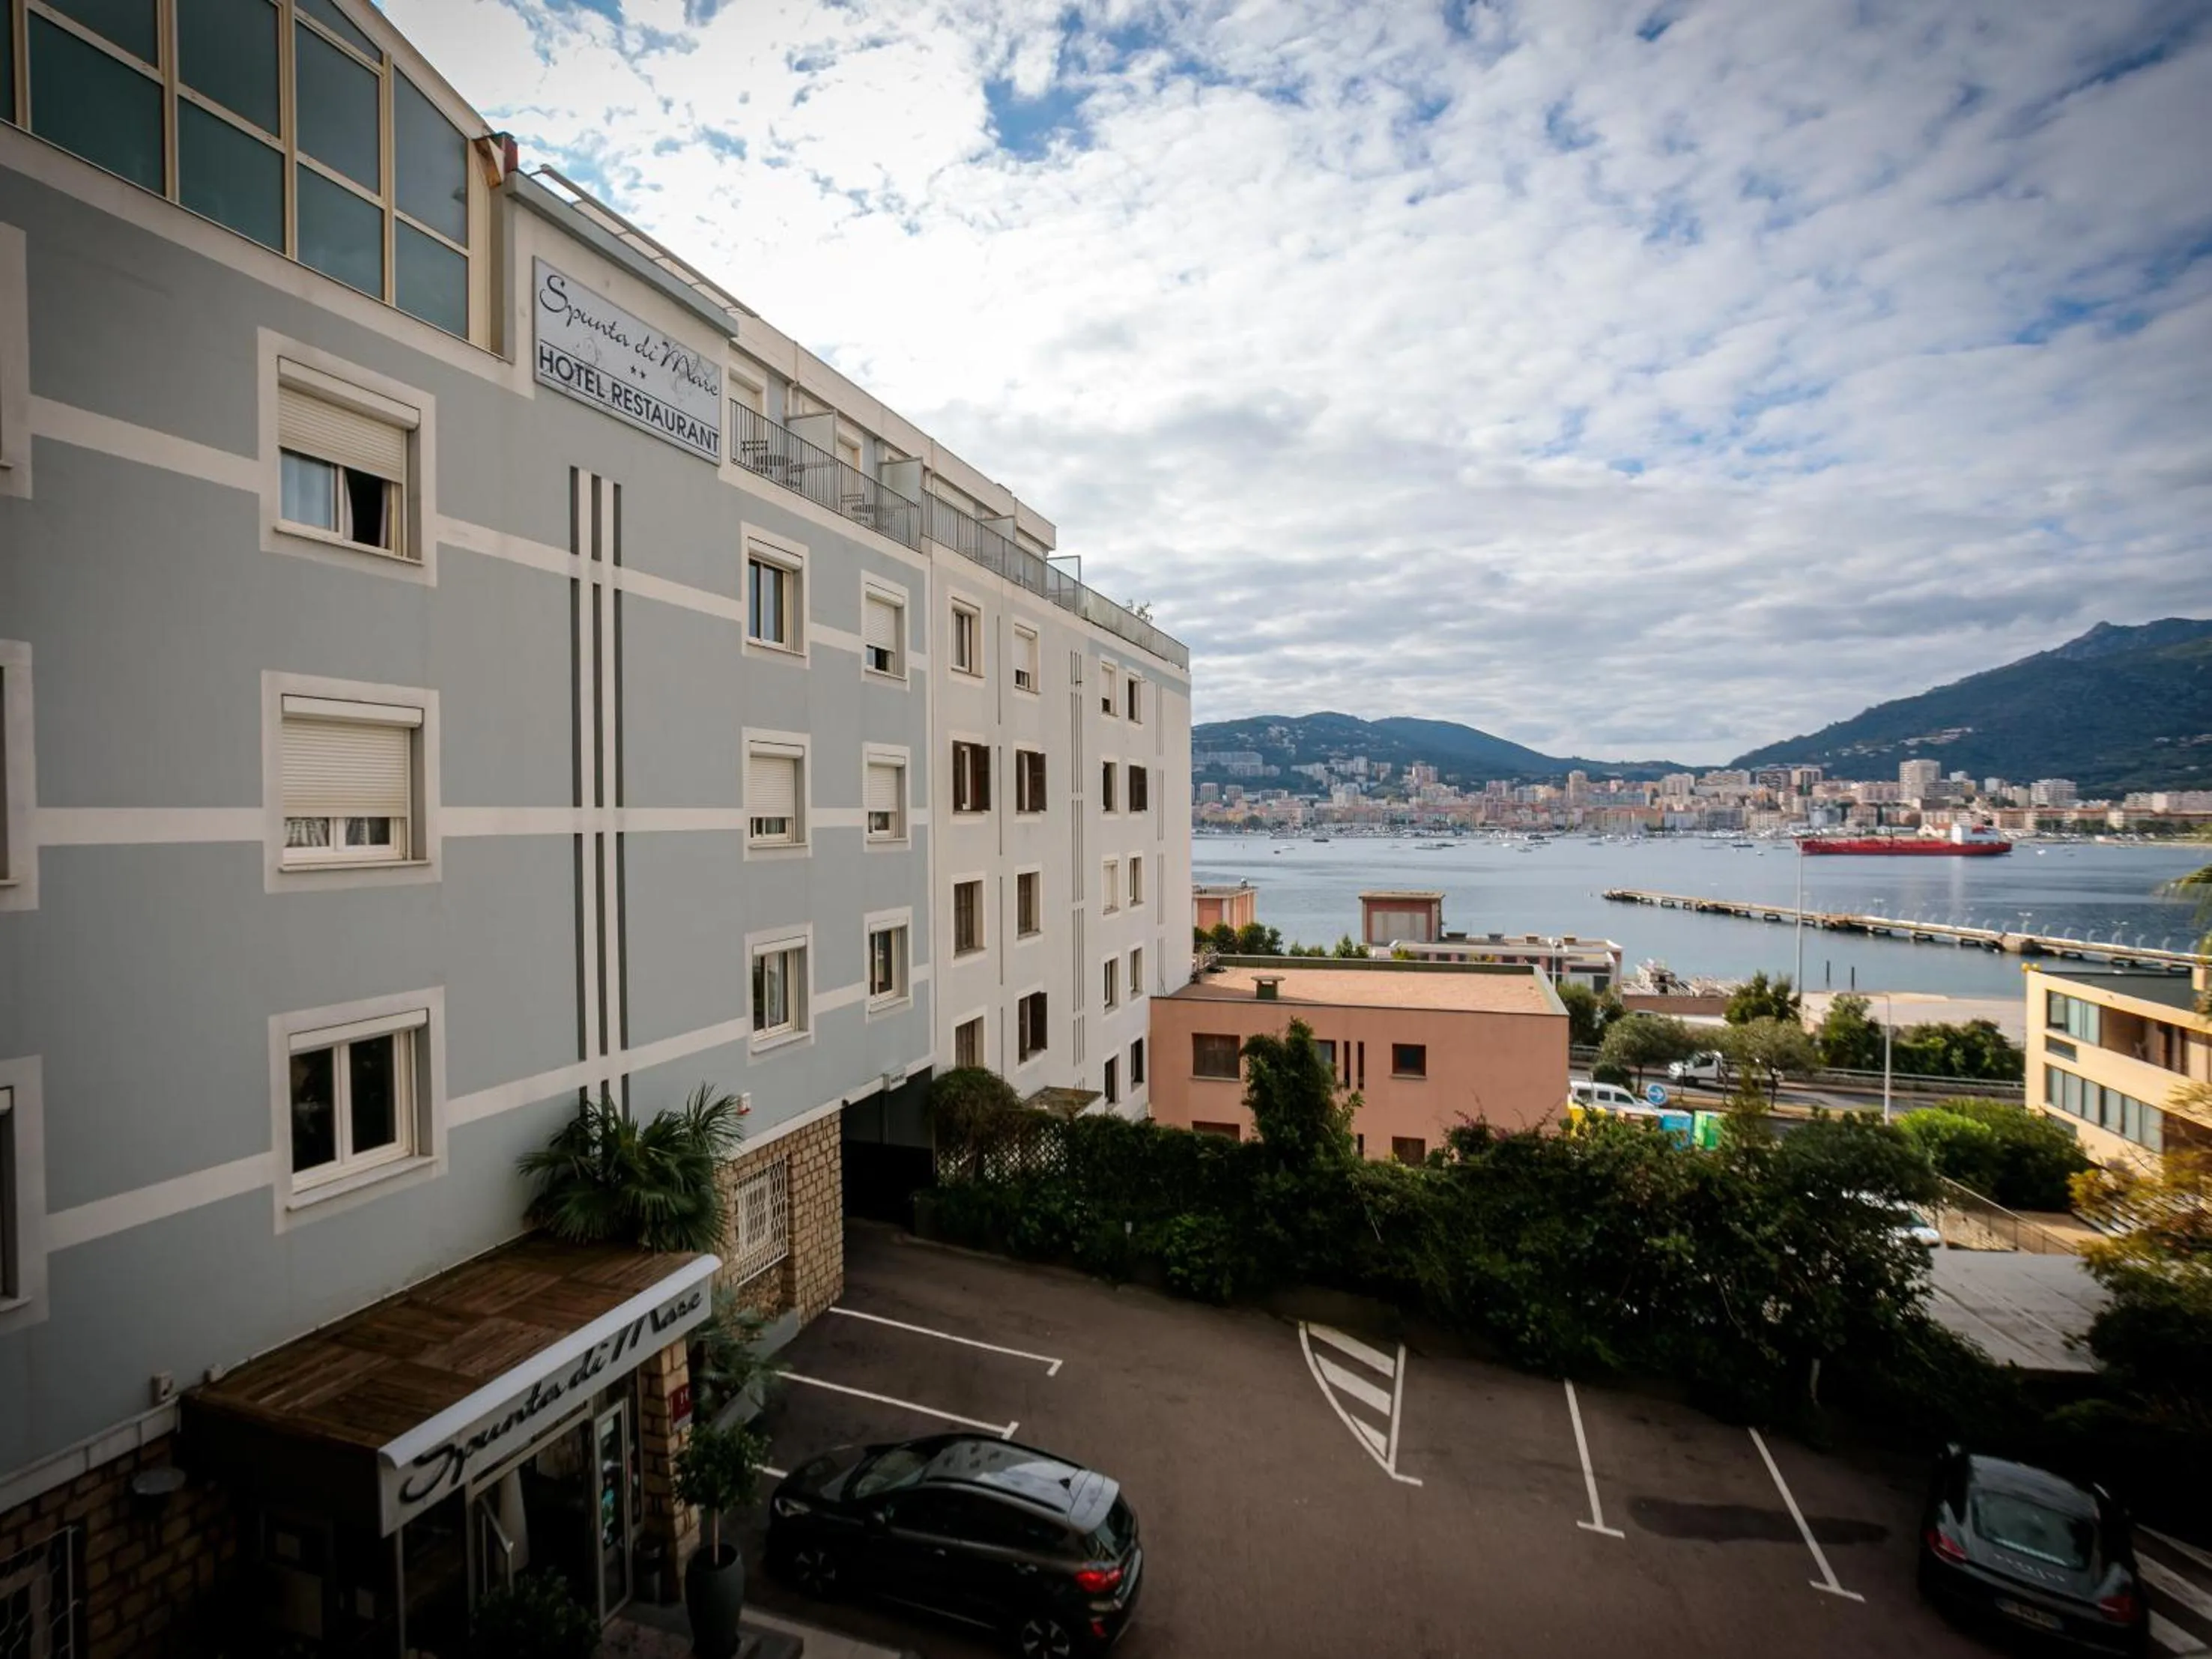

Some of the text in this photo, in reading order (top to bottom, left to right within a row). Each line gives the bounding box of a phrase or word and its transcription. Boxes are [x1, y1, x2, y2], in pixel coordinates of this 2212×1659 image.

[539, 275, 719, 396] Spunta di Mare
[539, 345, 719, 452] HOTEL RESTAURANT
[400, 1379, 567, 1503] Spunta
[568, 1341, 610, 1389] di
